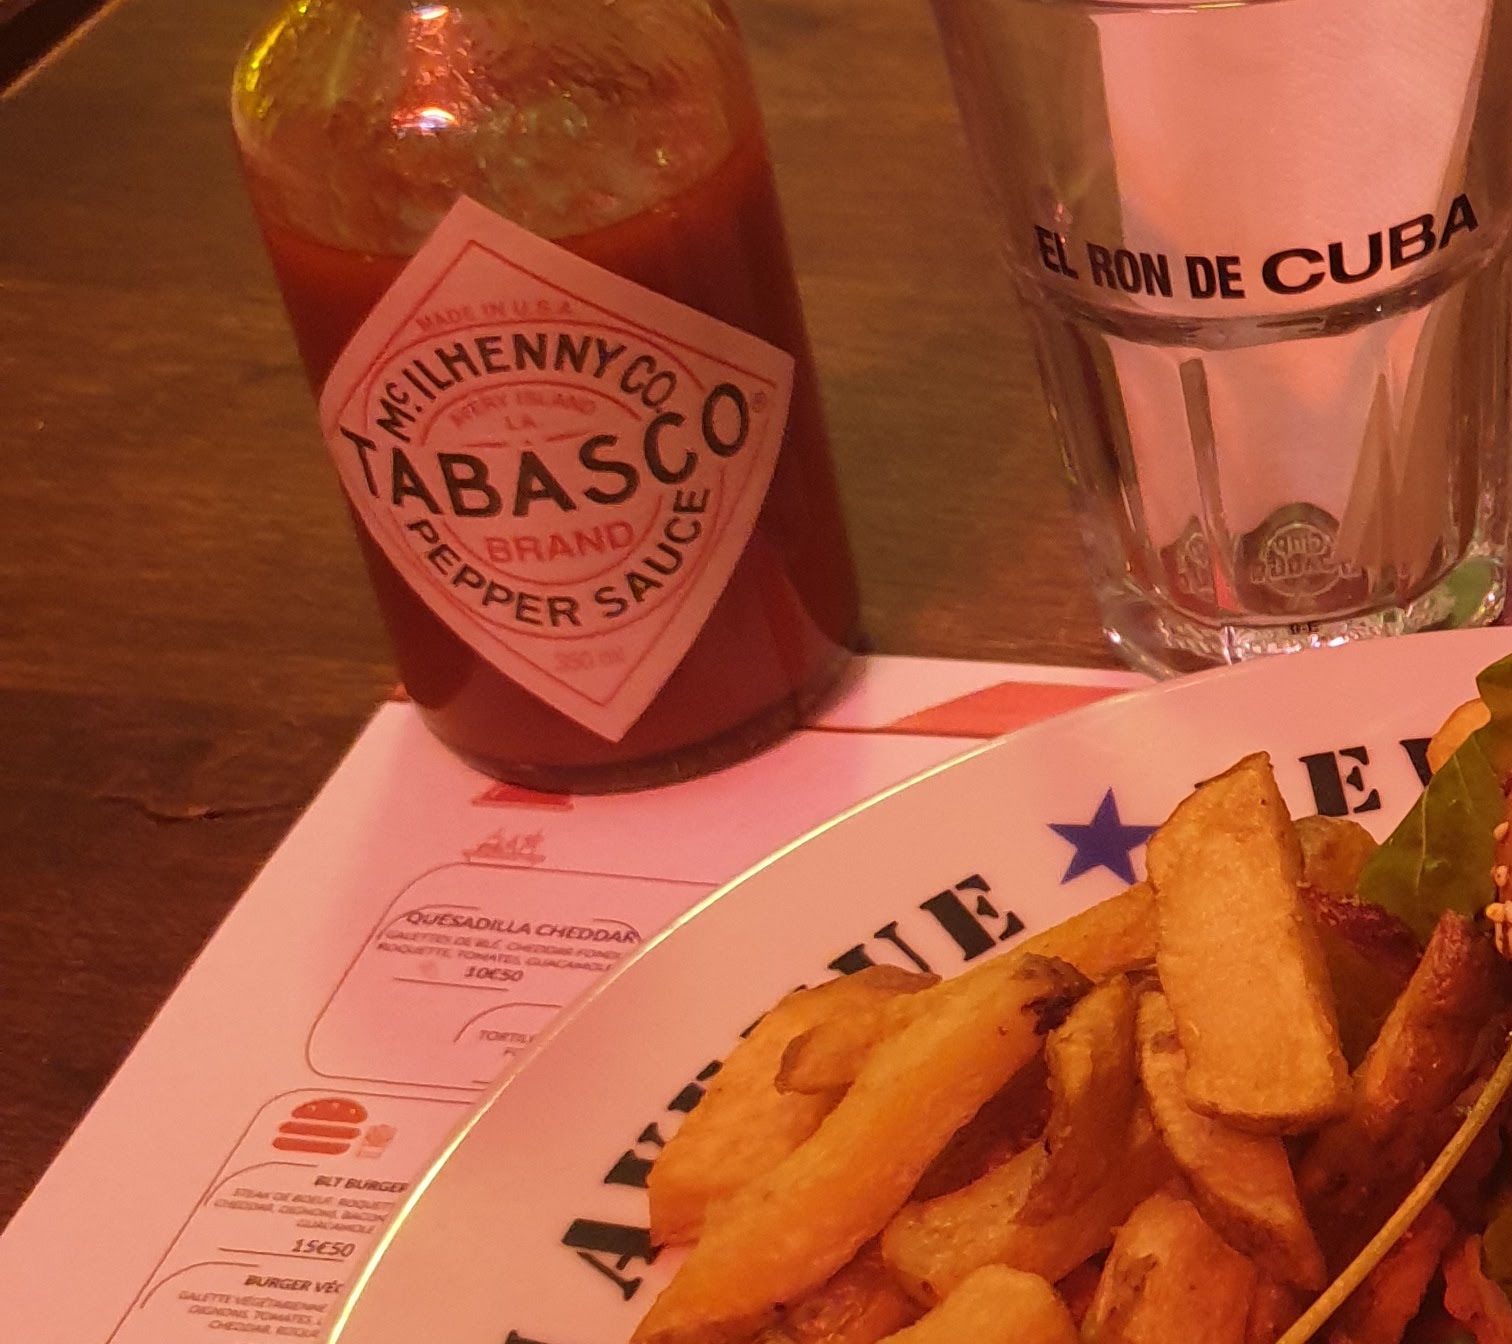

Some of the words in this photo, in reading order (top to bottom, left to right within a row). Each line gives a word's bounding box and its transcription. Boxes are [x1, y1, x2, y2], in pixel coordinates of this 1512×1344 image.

[1034, 224, 1079, 280] EL
[1087, 242, 1174, 298] RON
[1185, 255, 1247, 300] DE
[1262, 193, 1480, 295] CUBA
[340, 382, 750, 518] TABASCO
[406, 518, 582, 627] PEPPER
[594, 488, 711, 618] SAUCE
[487, 520, 635, 564] BRAND
[405, 910, 532, 936] QUESADILLA
[535, 923, 639, 945] CHEDDAR
[291, 1238, 357, 1257] 15€50
[244, 1274, 313, 1292] BURGER
